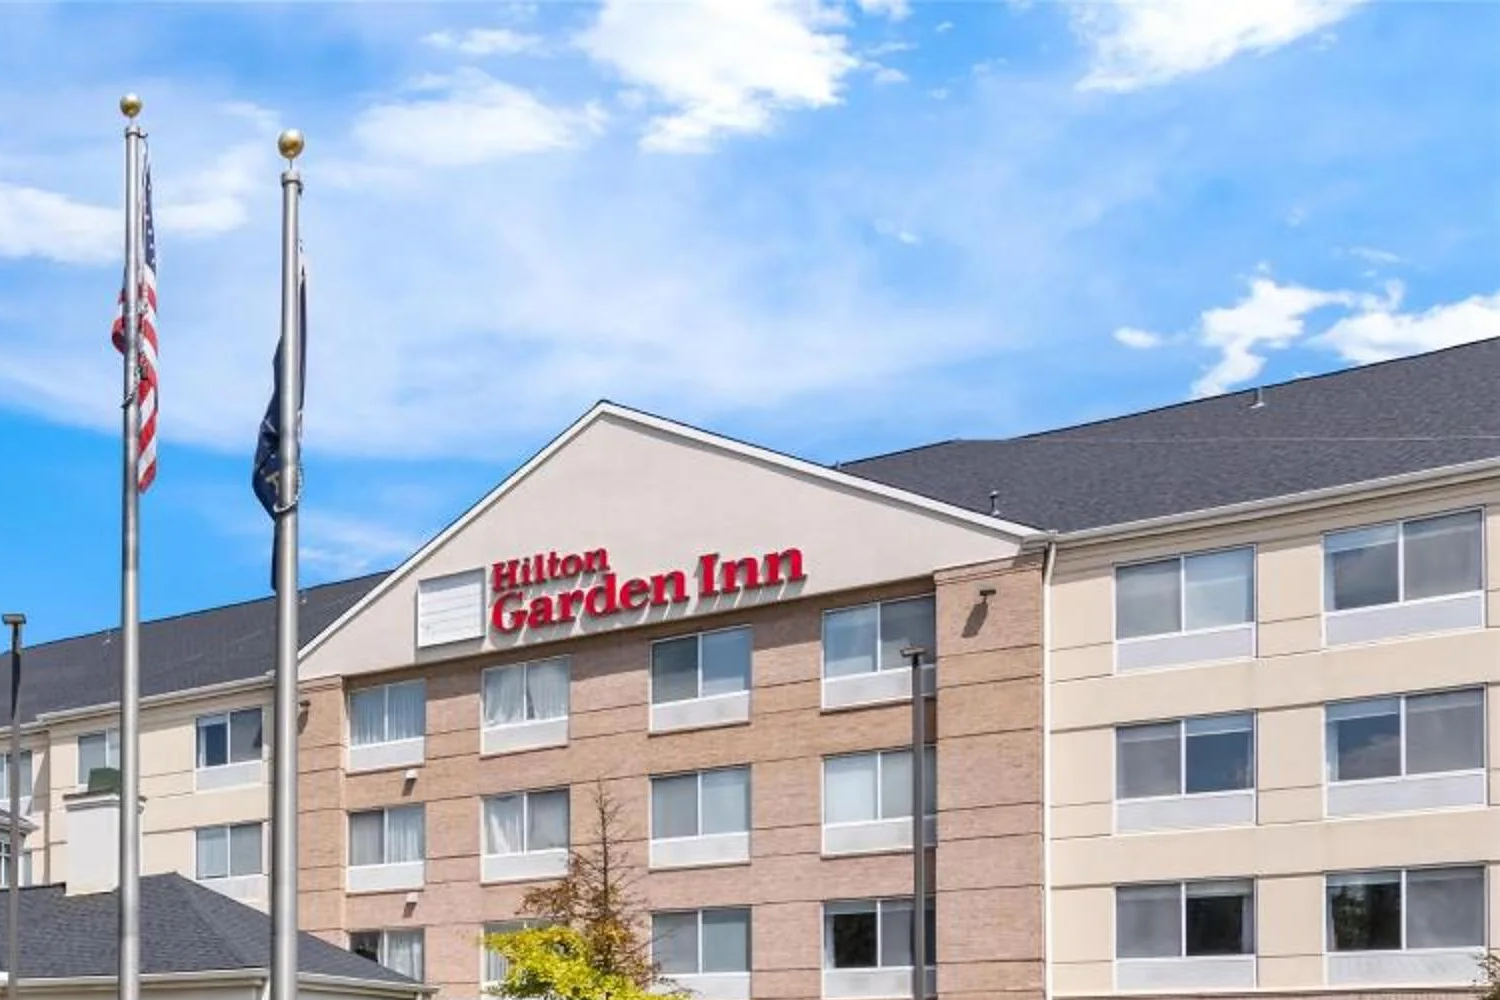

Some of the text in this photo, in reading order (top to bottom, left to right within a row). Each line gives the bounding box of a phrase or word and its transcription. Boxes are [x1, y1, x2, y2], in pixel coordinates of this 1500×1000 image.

[491, 547, 610, 592] Hilton
[491, 546, 806, 634] Garden Inn
